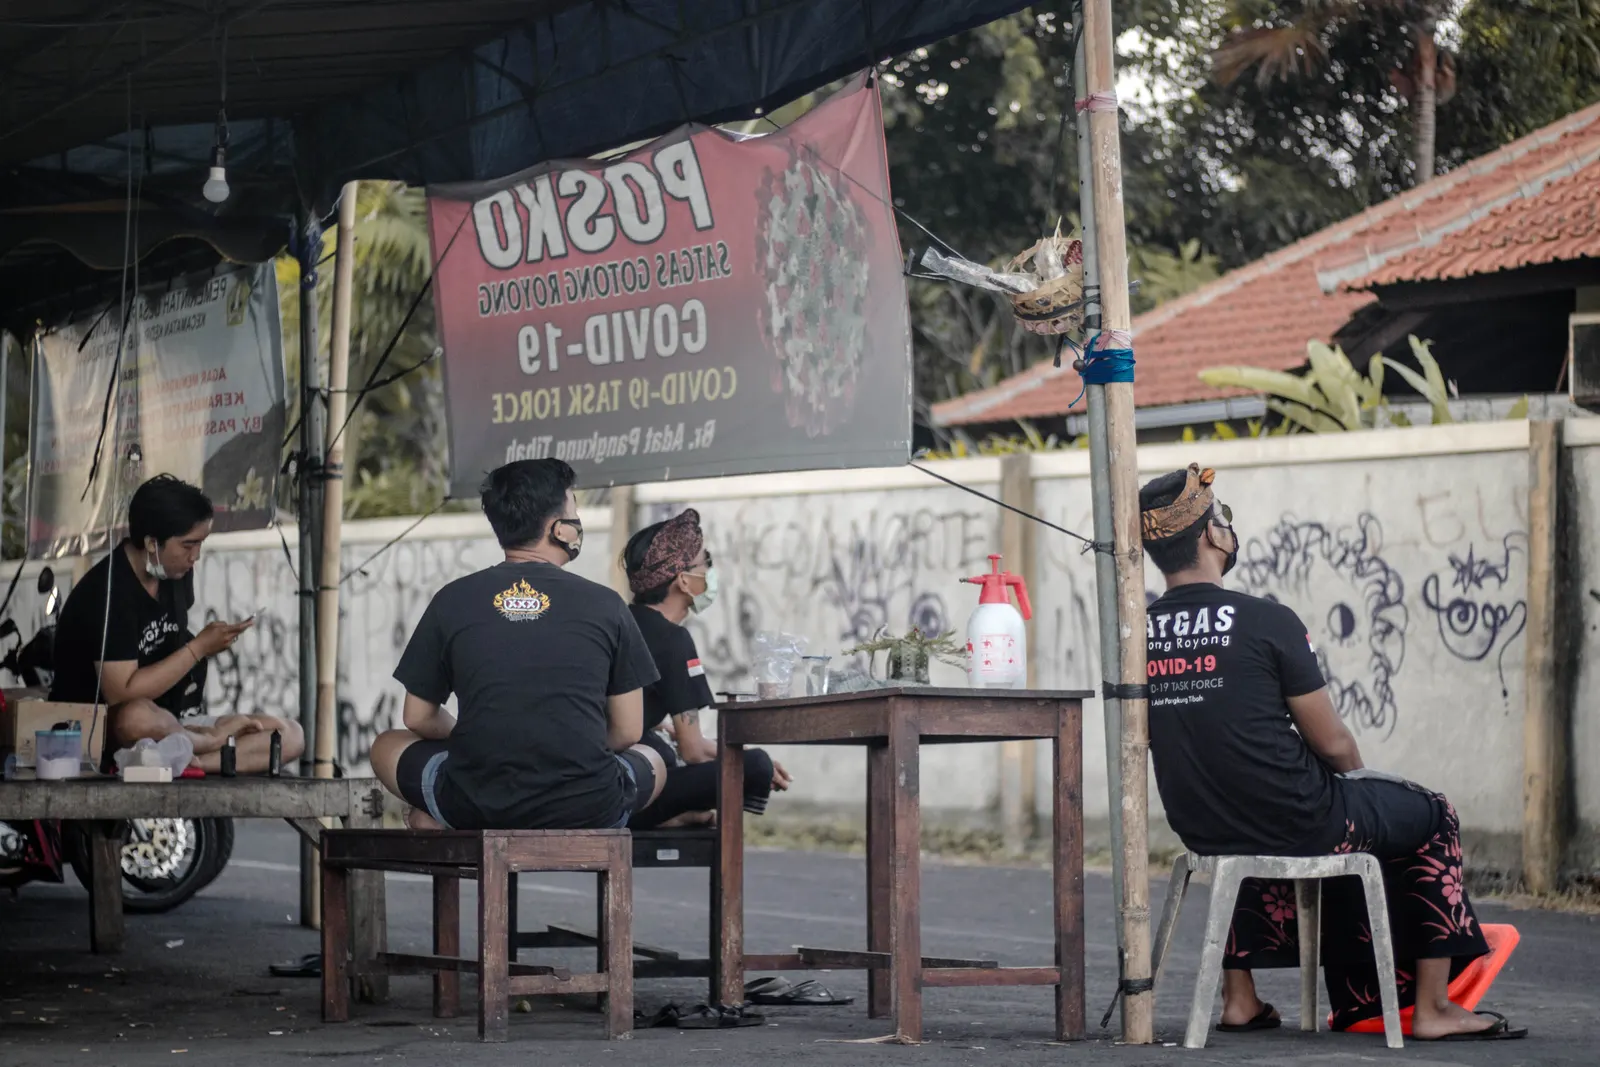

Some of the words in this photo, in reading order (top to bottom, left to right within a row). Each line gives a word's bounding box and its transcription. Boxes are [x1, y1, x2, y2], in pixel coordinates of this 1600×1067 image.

[508, 599, 536, 609] XXX
[1146, 605, 1235, 639] ATGAS
[1148, 639, 1172, 652] ong
[1176, 634, 1230, 650] Royong
[1147, 654, 1217, 677] OVID-19
[1150, 682, 1169, 694] D-19
[1171, 680, 1189, 692] TASK
[1190, 677, 1224, 690] FORCE
